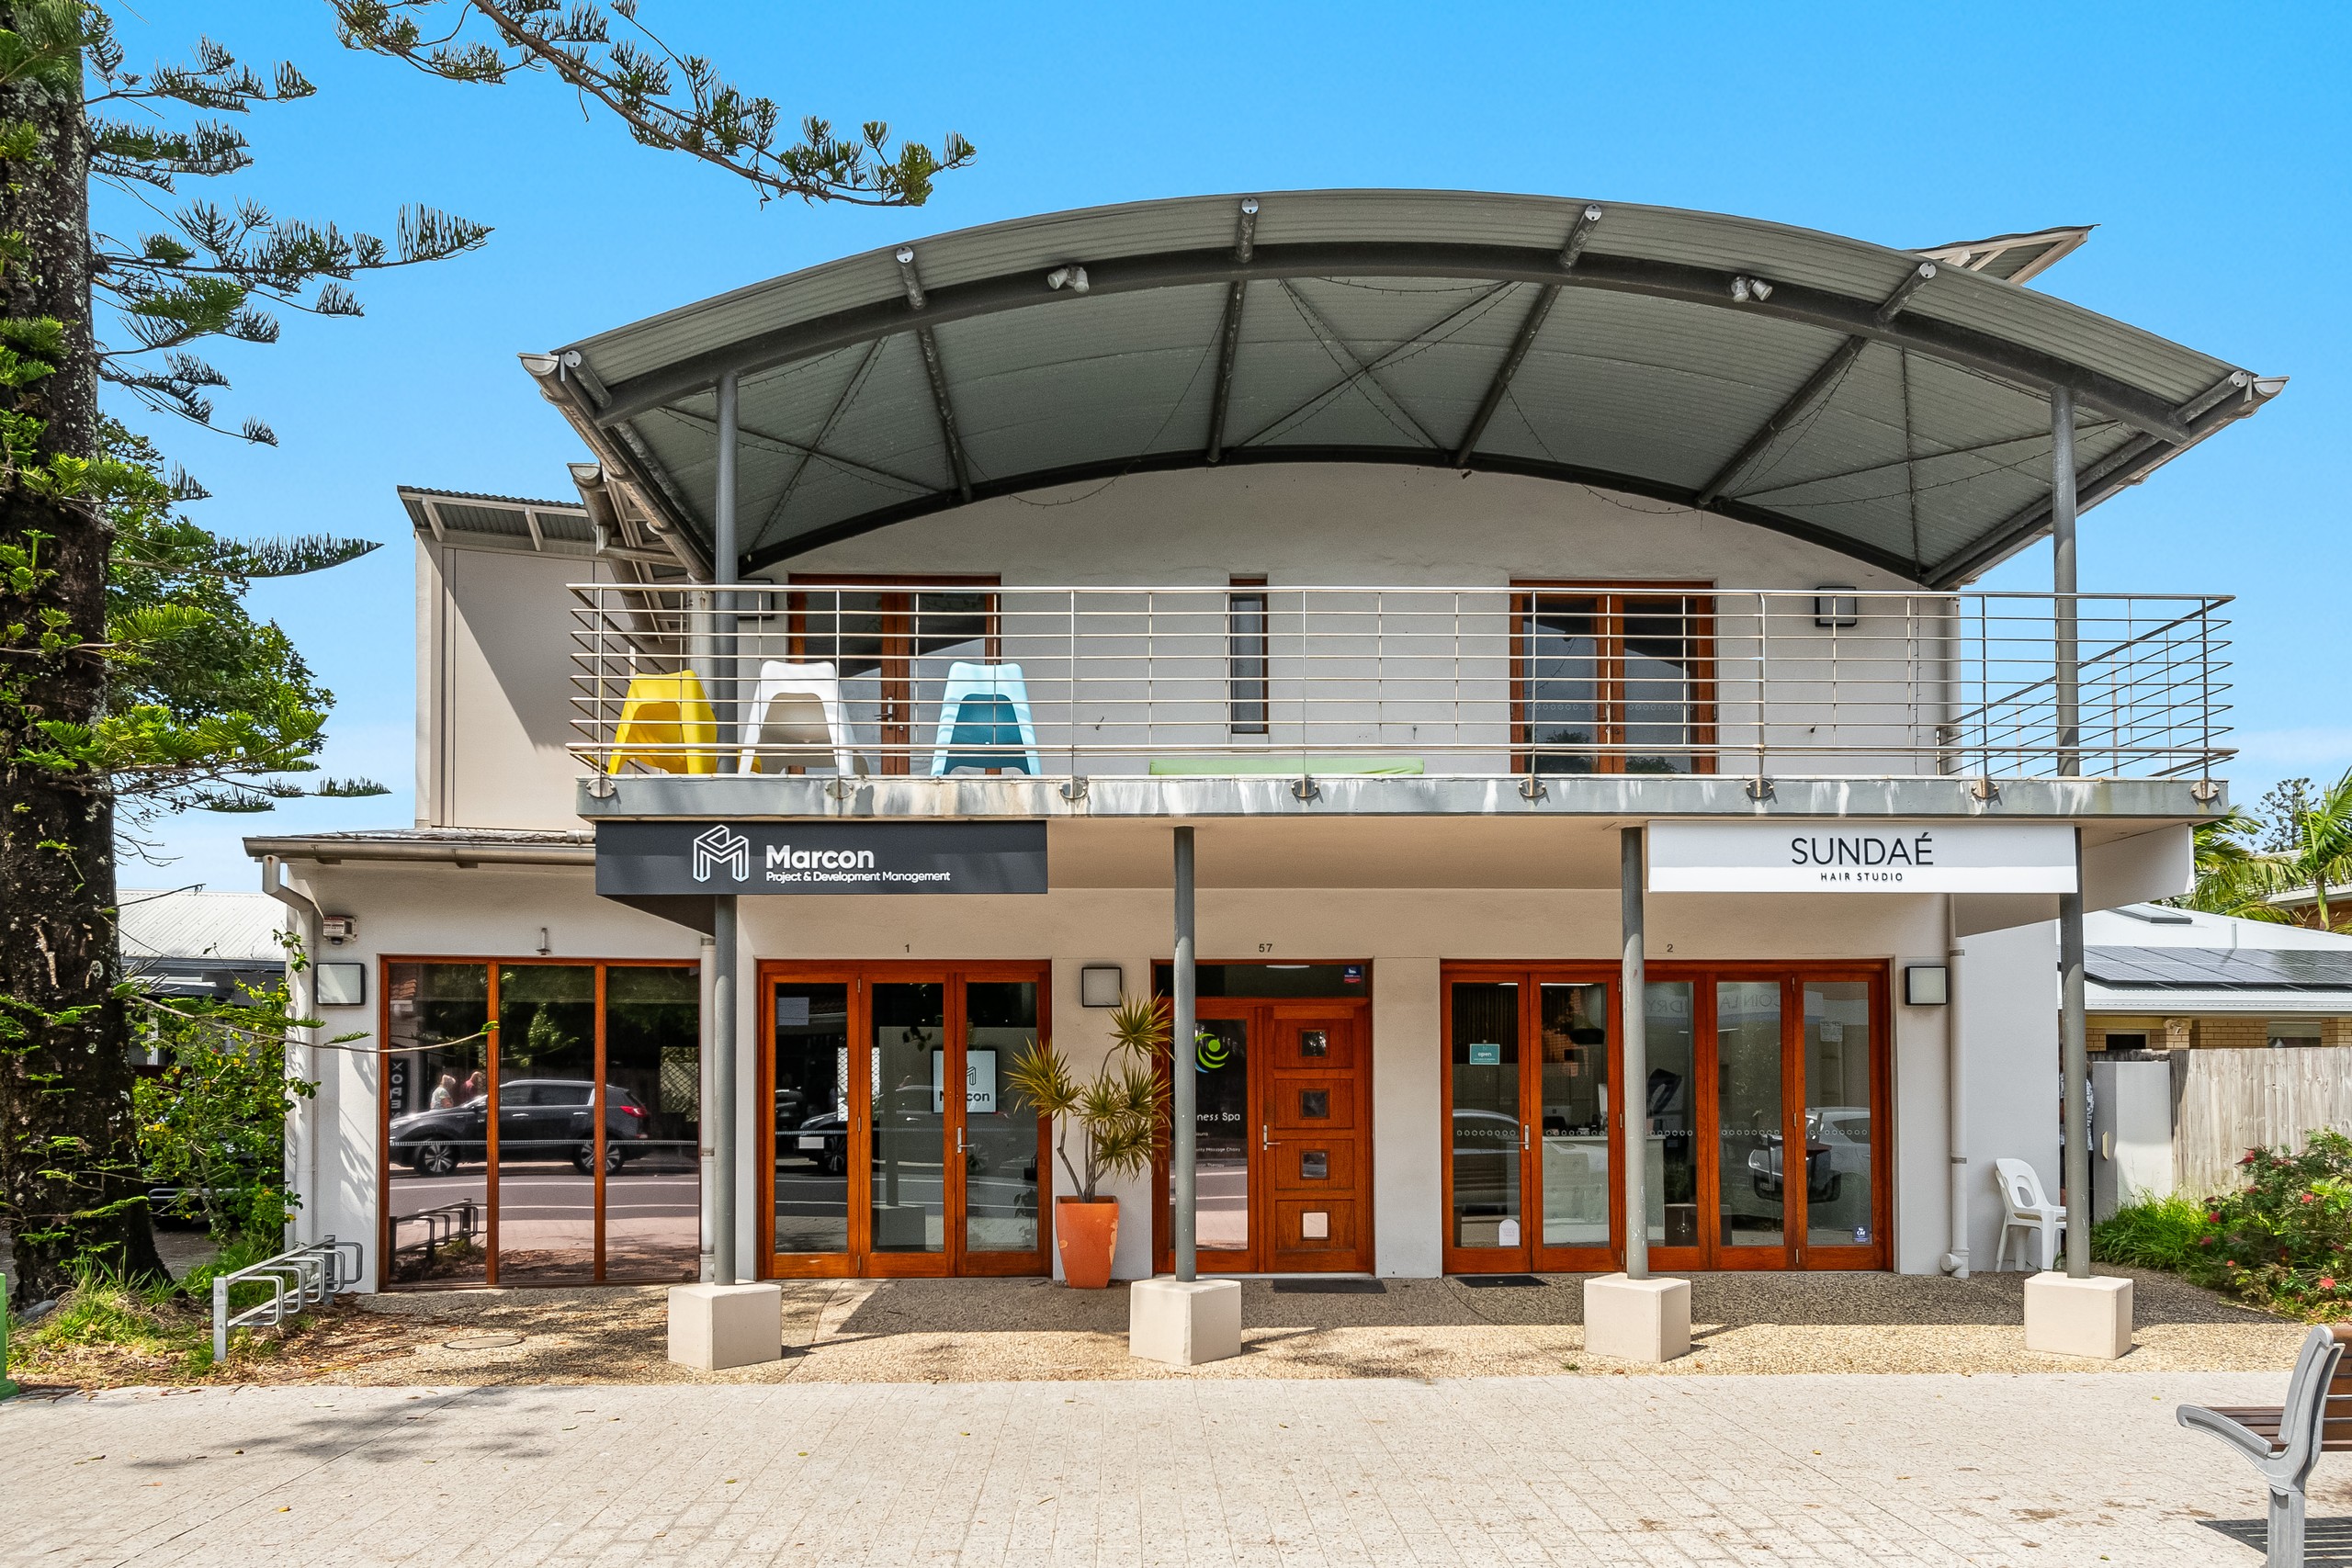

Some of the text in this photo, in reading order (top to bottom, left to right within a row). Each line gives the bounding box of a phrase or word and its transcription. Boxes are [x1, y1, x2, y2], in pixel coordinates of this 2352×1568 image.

[1791, 831, 1934, 865] SUNDAÉ
[765, 844, 875, 869] Marcon
[765, 871, 950, 884] Project & Development Management
[1820, 873, 1903, 882] HAIR STUDIO
[904, 943, 910, 953] 1
[1258, 943, 1272, 953] 57
[1666, 943, 1674, 953] 2
[1222, 1111, 1240, 1122] Spa
